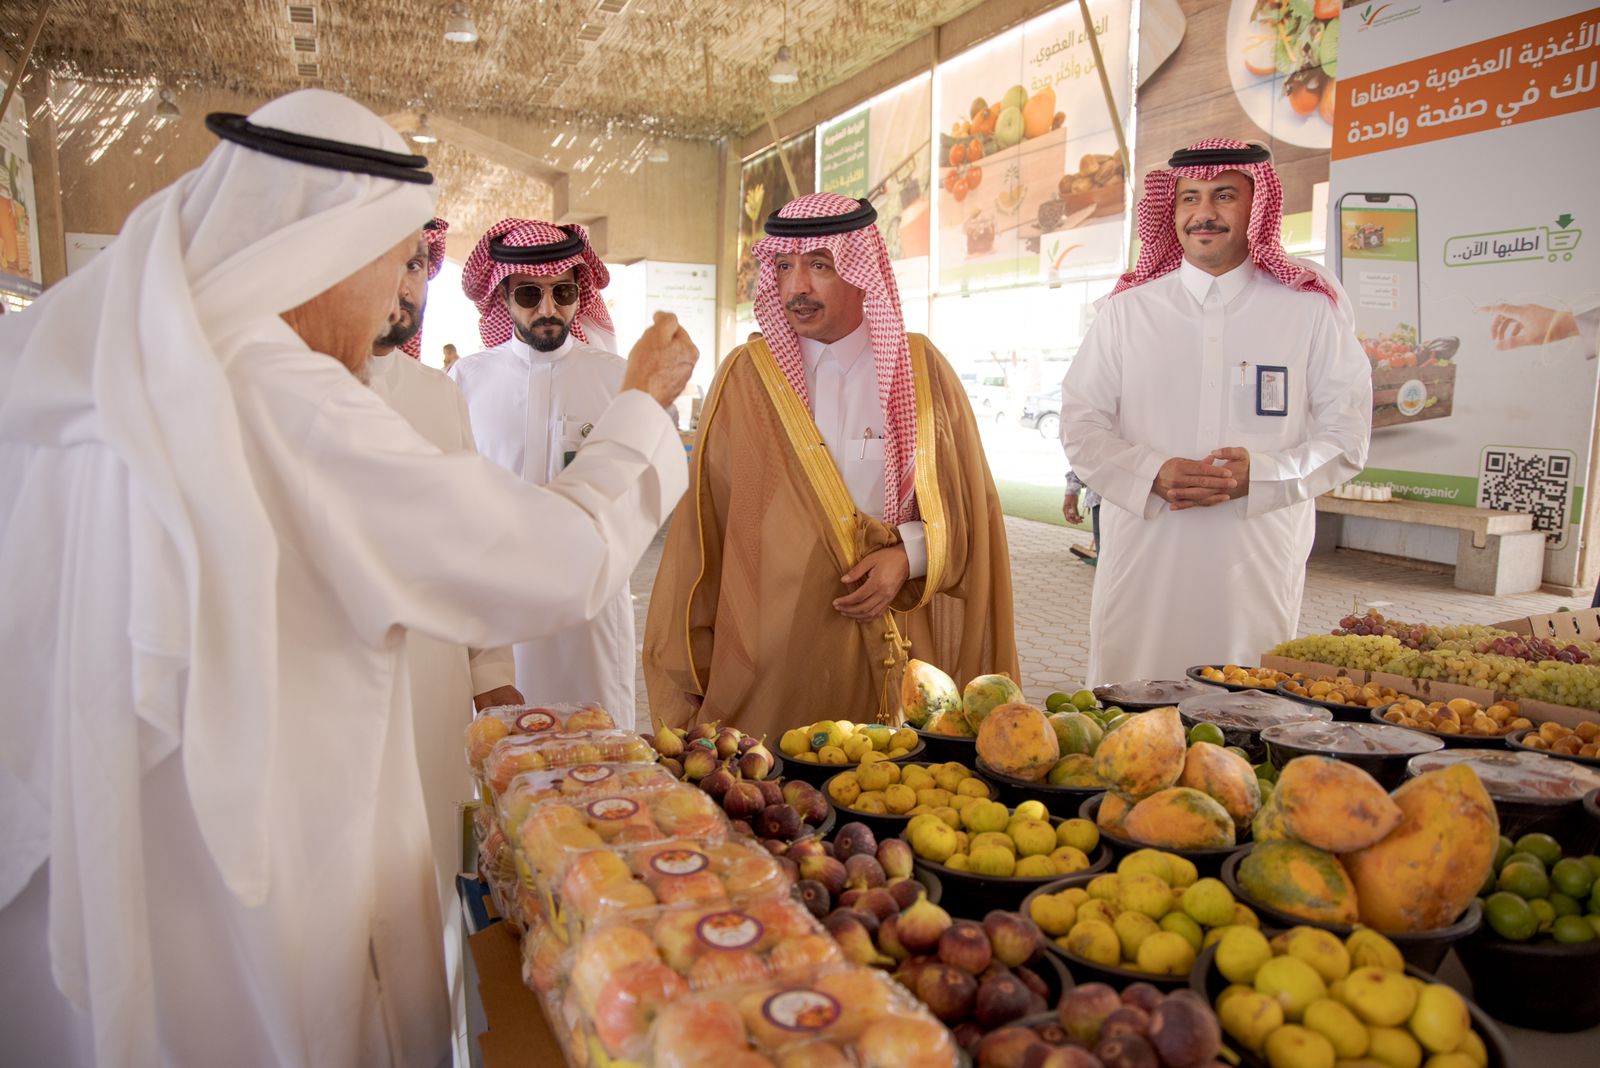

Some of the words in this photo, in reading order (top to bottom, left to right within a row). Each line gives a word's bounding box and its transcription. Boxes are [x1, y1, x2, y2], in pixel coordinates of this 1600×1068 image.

[1518, 21, 1600, 69] الأغذية
[1426, 47, 1512, 91] العضوية
[1550, 60, 1598, 99] لك
[1351, 82, 1420, 107] جمعناها
[1416, 97, 1488, 128] صفحة
[1495, 79, 1540, 126] في
[1347, 111, 1409, 144] واحدة
[1493, 235, 1540, 259] اطلبها
